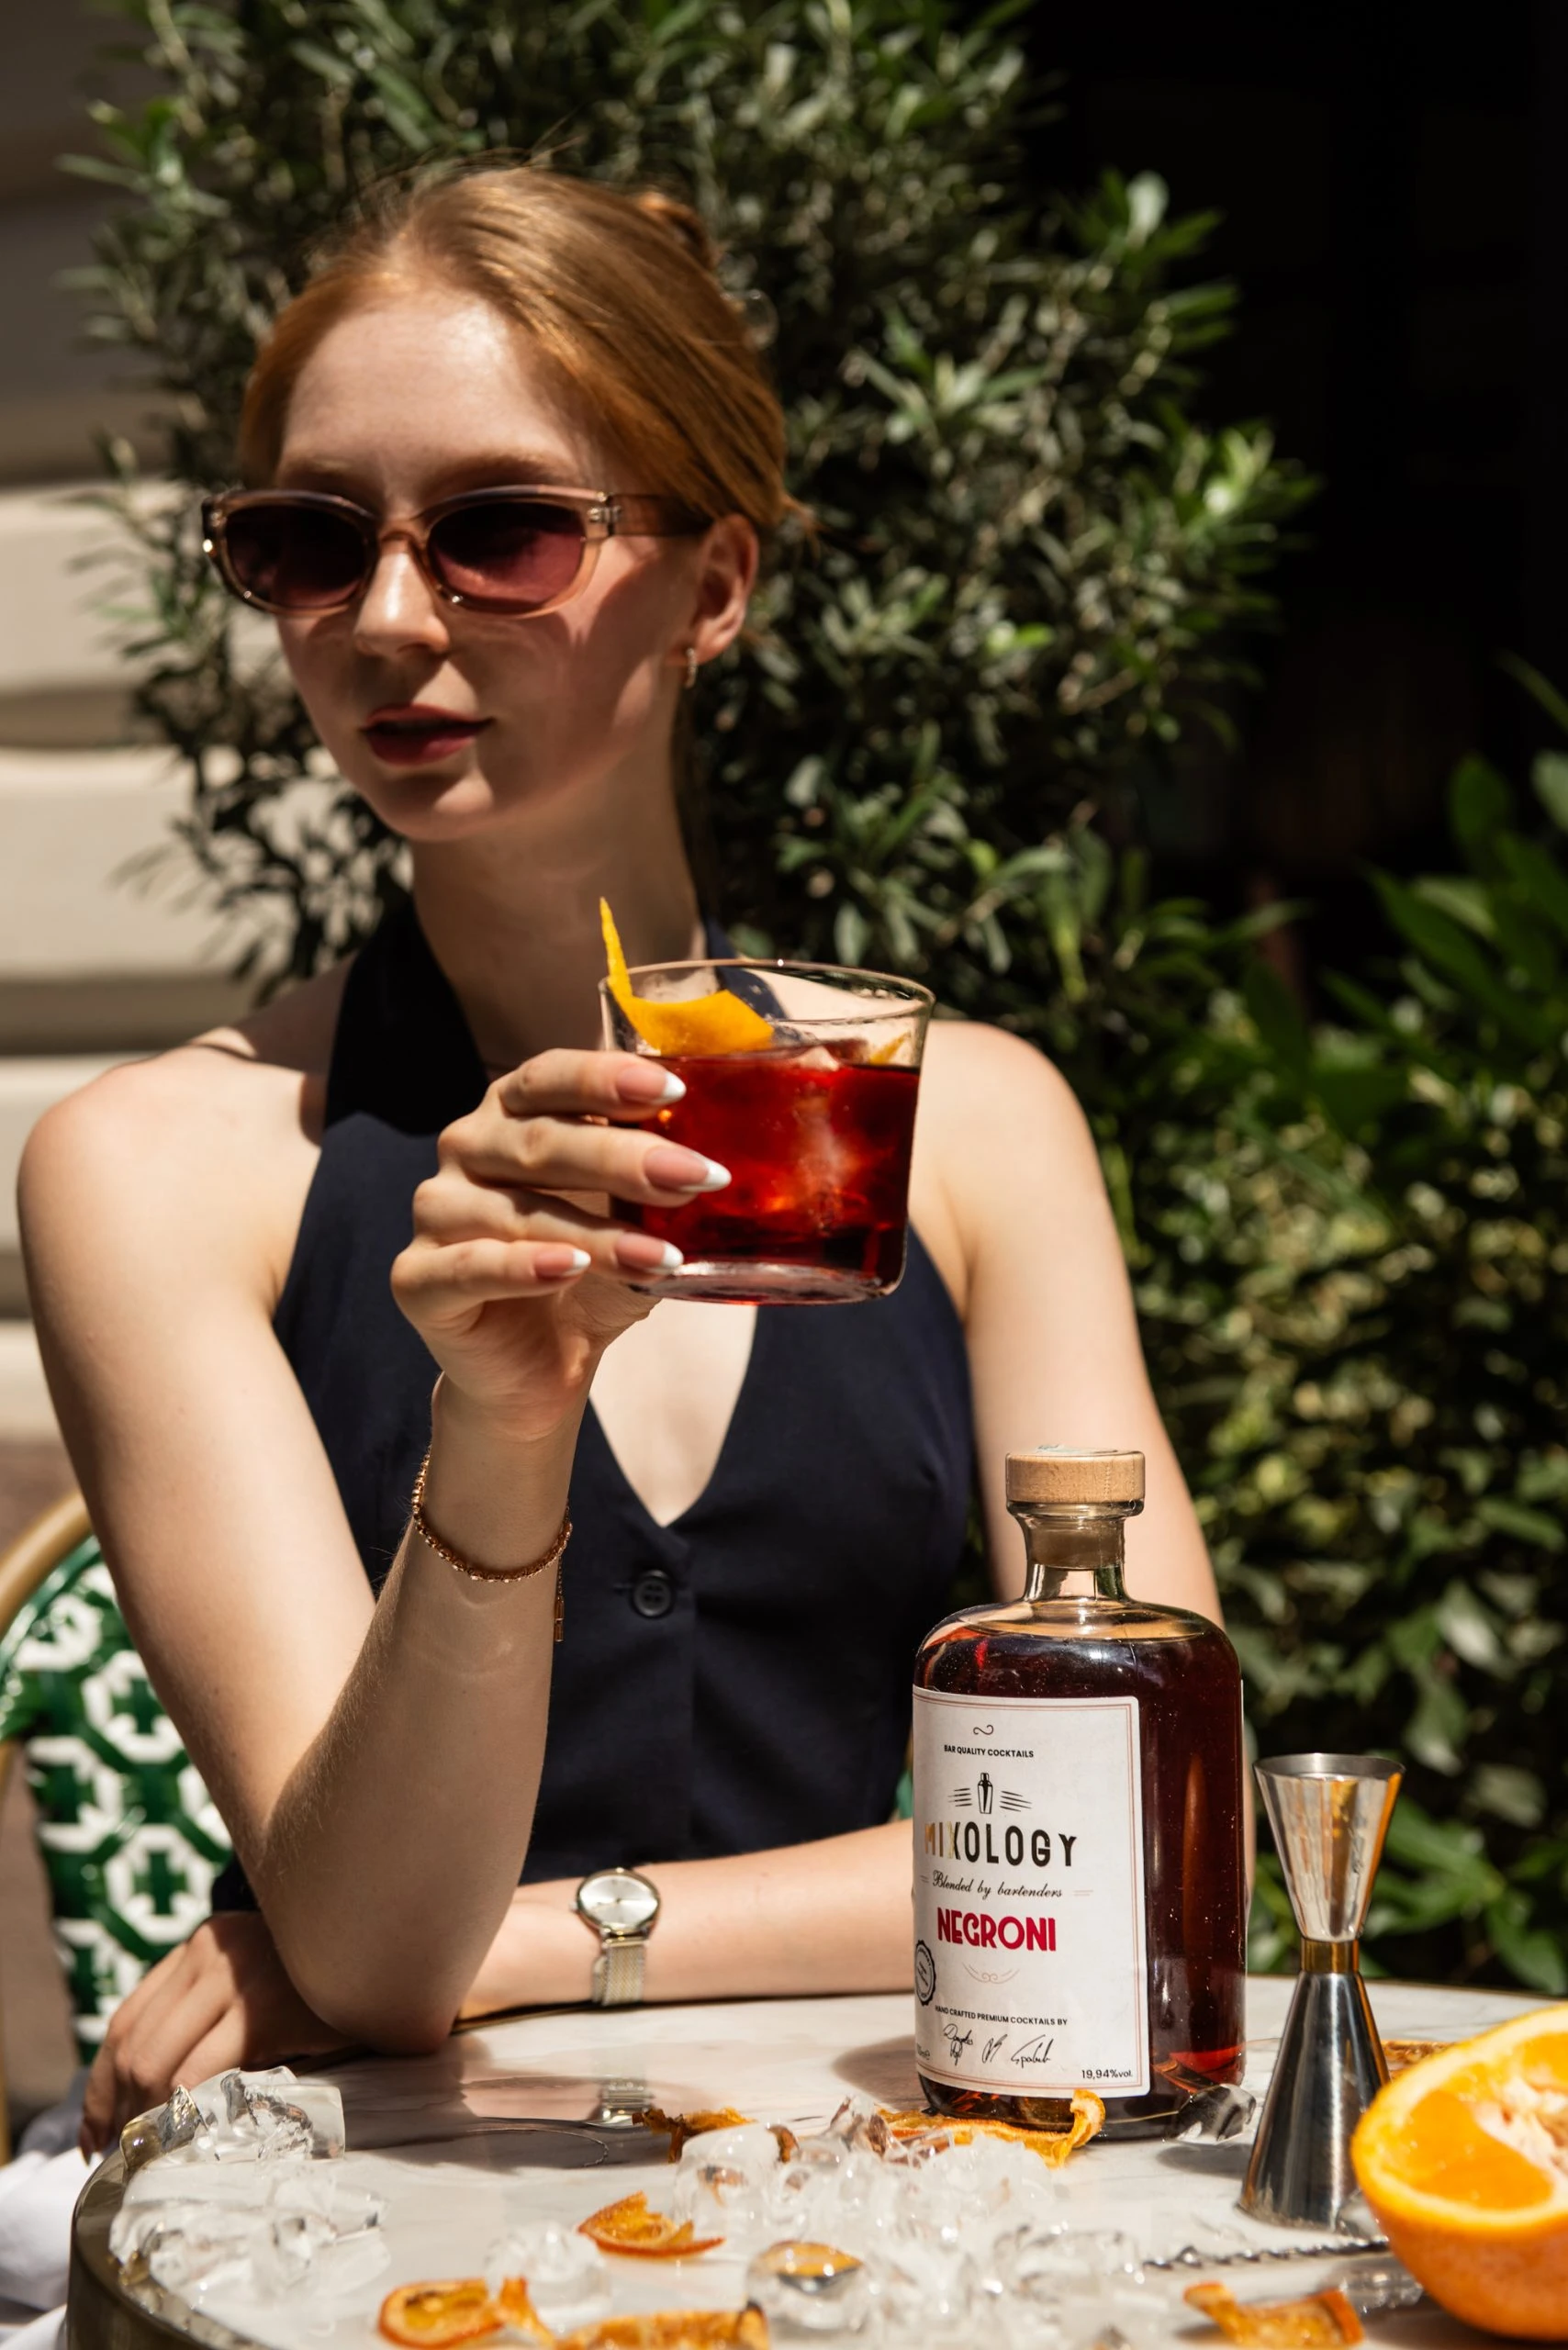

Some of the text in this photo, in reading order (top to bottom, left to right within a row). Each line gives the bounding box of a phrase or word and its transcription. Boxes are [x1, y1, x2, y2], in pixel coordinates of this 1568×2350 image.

[944, 1744, 1034, 1758] BAR QUALITY COCKTAILS
[924, 1821, 1077, 1867] MIXOLOGY
[933, 1869, 1063, 1900] Blended by bartenders
[937, 1907, 1057, 1952] NEGRONI
[935, 2005, 1068, 2026] HAND CRAFTED PREMIUM COCKTAILS BY
